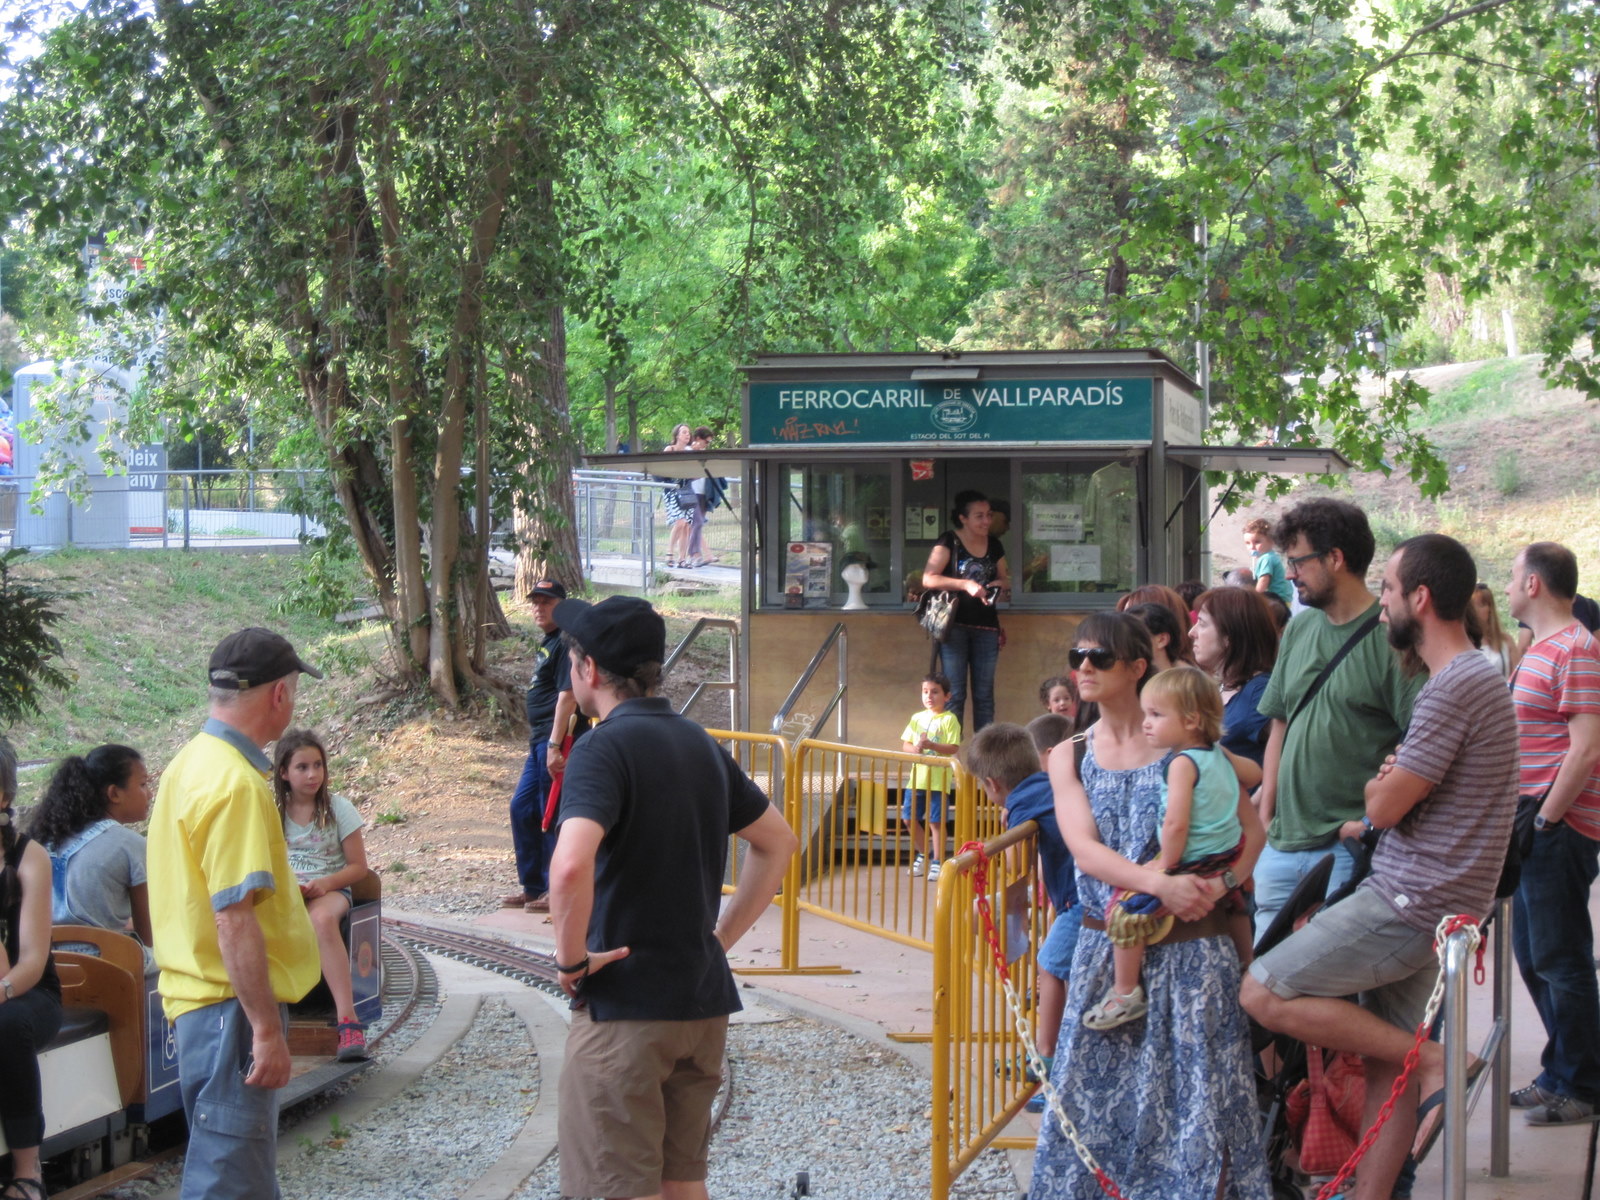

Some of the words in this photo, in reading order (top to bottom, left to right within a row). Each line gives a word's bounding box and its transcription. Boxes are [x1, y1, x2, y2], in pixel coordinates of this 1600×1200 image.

[779, 388, 933, 410] FERROCARRIL
[943, 388, 961, 400] DE
[971, 380, 1123, 407] VALLPARADÍS
[910, 432, 937, 440] ESTACIÓ
